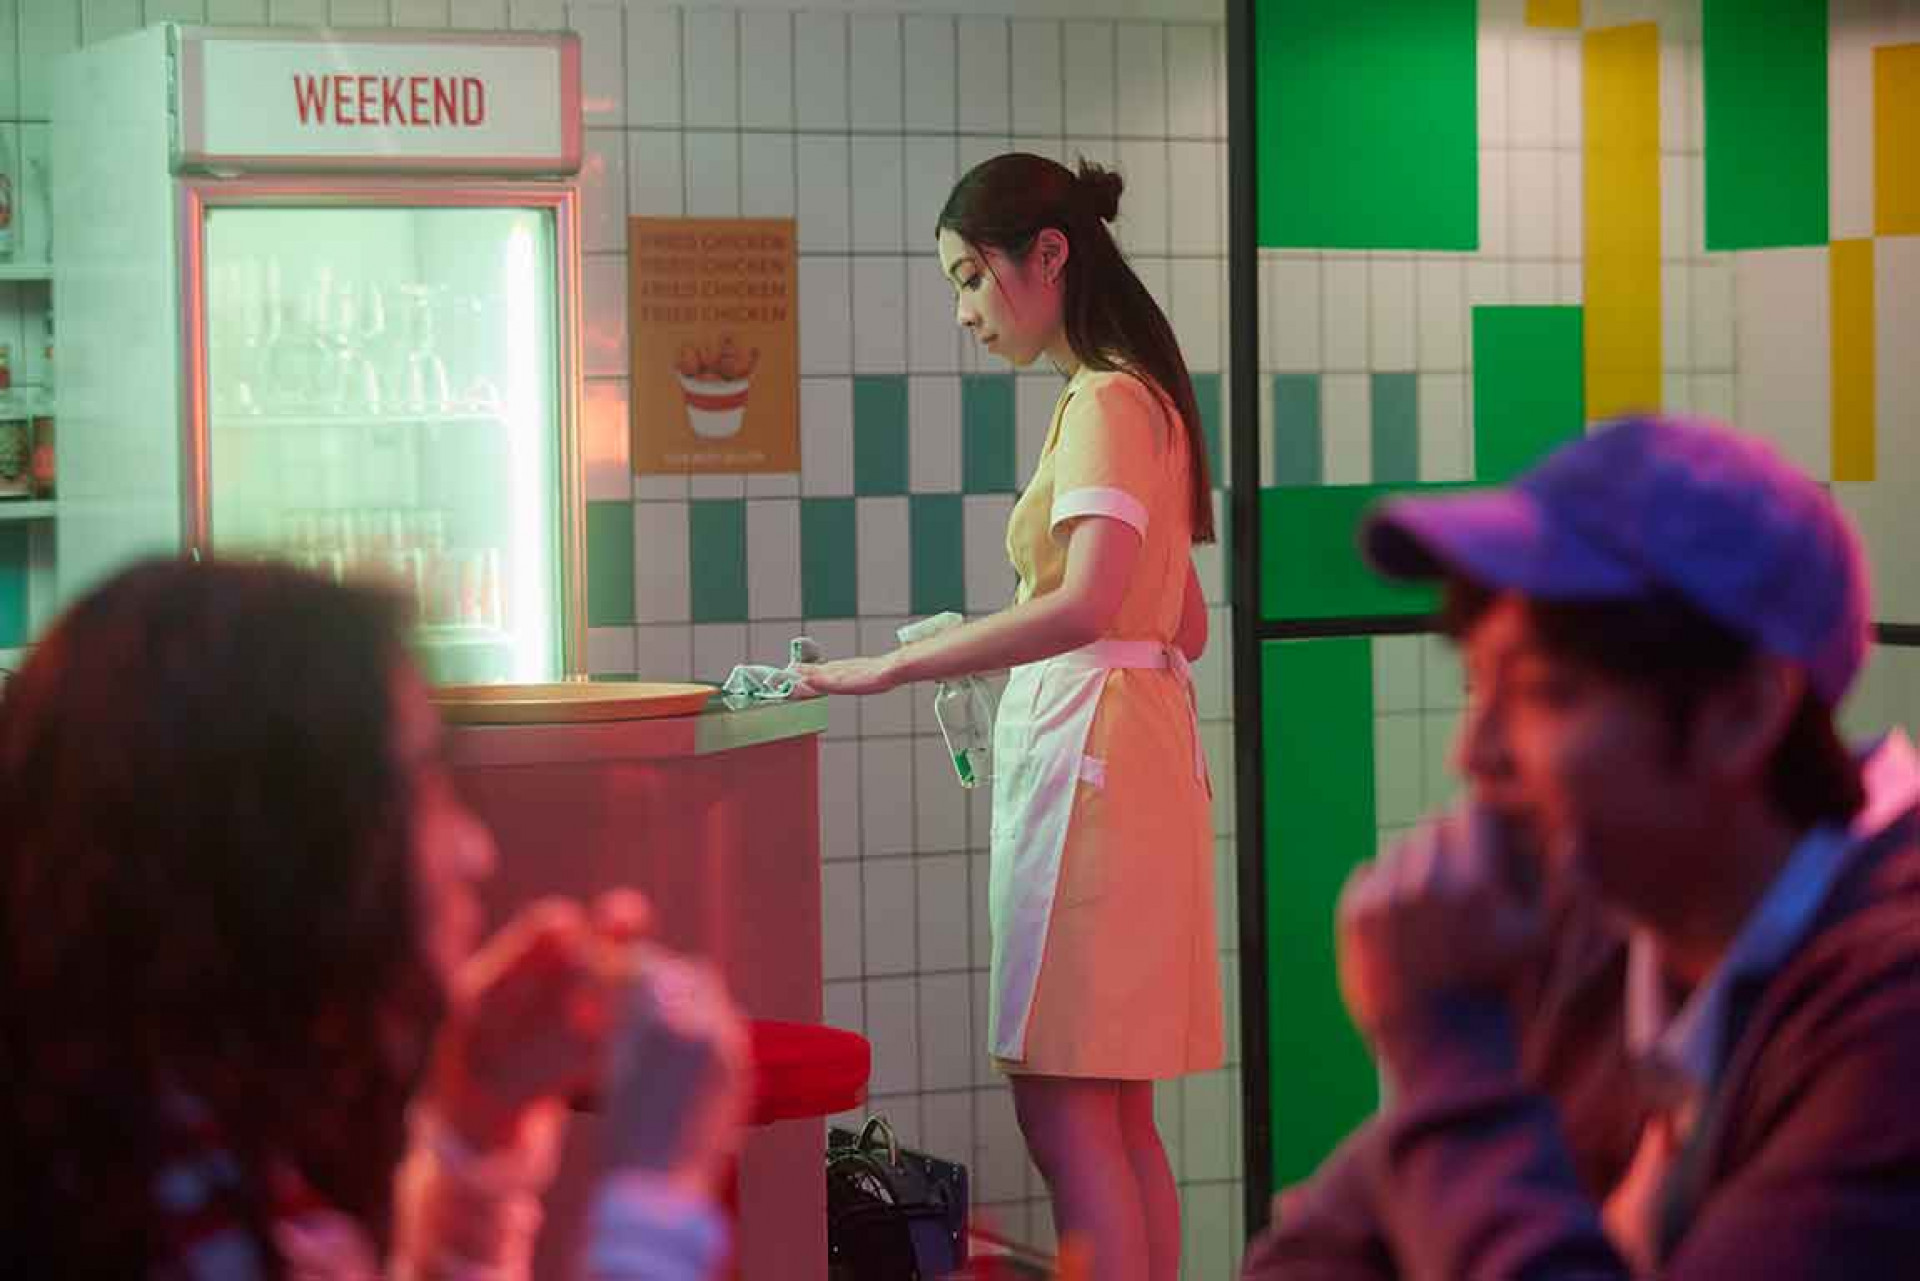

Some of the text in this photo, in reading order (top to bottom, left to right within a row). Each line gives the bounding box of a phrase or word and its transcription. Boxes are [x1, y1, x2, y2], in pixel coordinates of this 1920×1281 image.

[293, 74, 485, 126] WEEKEND
[702, 280, 787, 297] CHICKEN
[702, 306, 787, 322] CHICKEN
